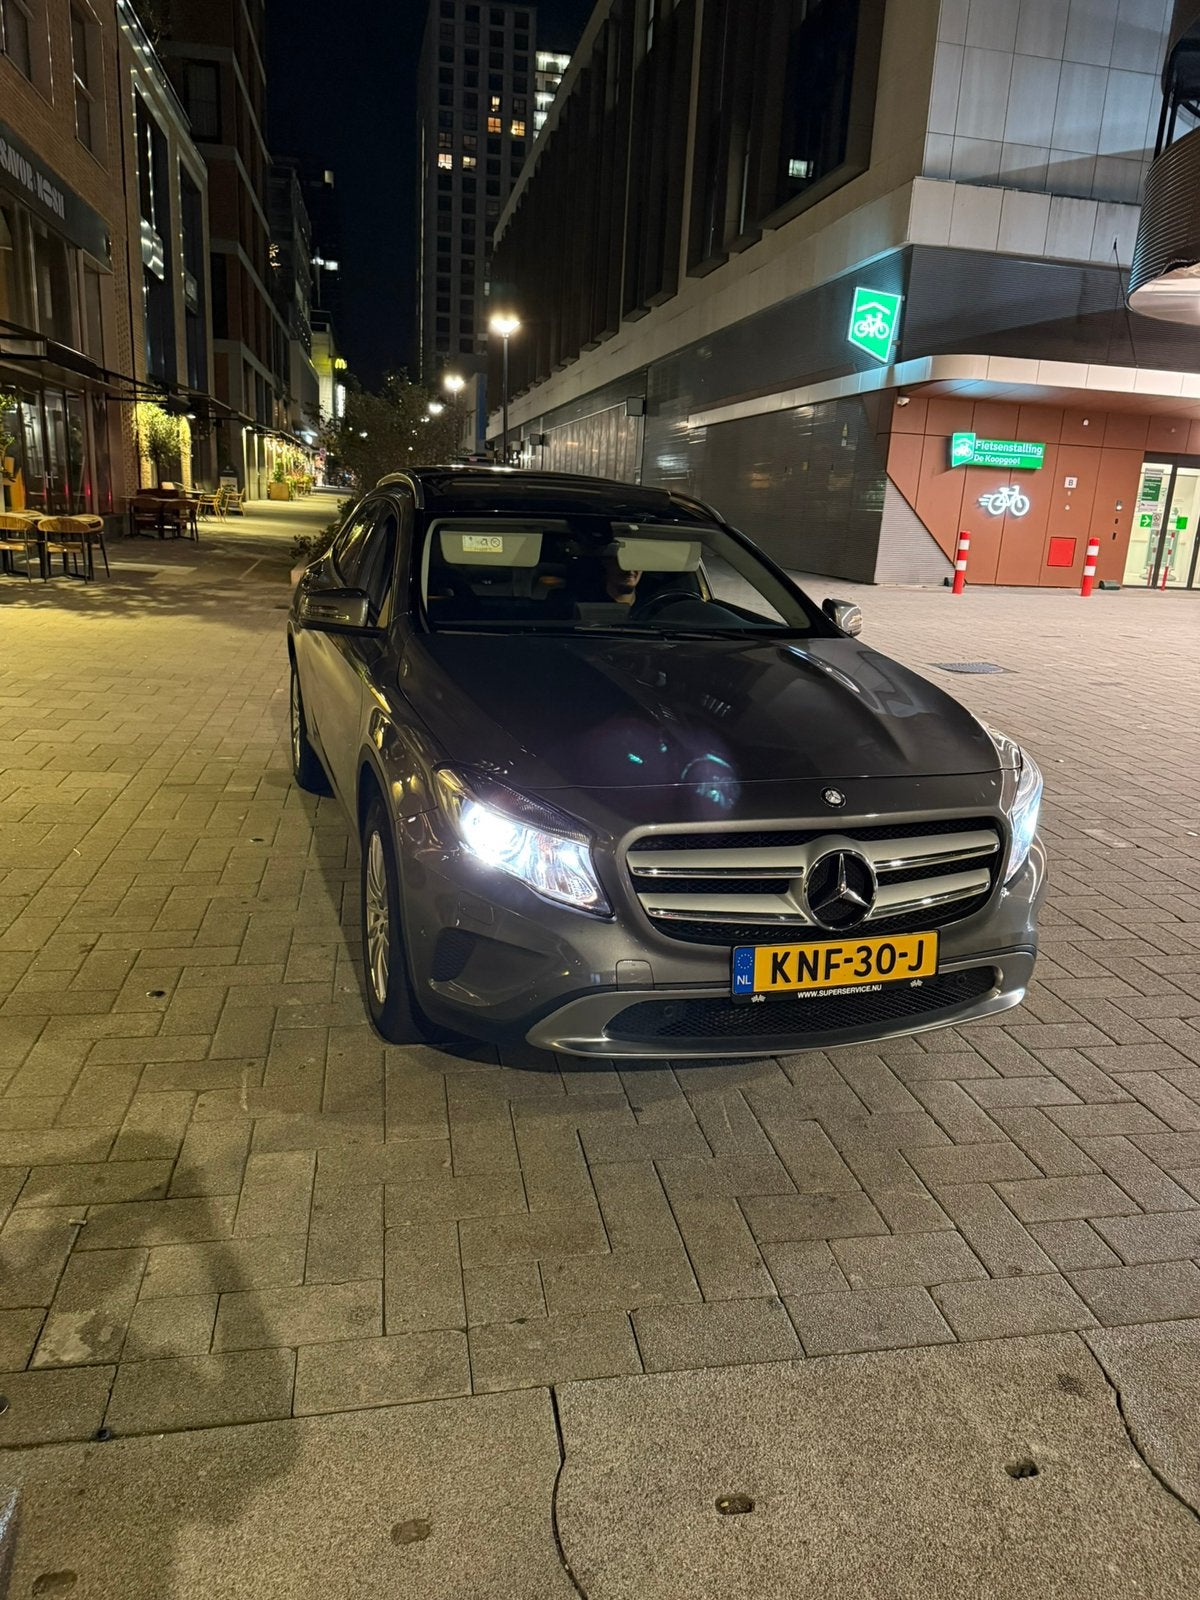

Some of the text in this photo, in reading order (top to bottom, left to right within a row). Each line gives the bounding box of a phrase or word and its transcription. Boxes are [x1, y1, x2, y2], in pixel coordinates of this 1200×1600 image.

[975, 441, 1043, 456] Fietsenstalling
[973, 454, 984, 462] De
[771, 939, 925, 985] KNF-30-J
[736, 974, 752, 986] NL
[797, 984, 882, 999] WWW.SUPERSERVICE.NU
